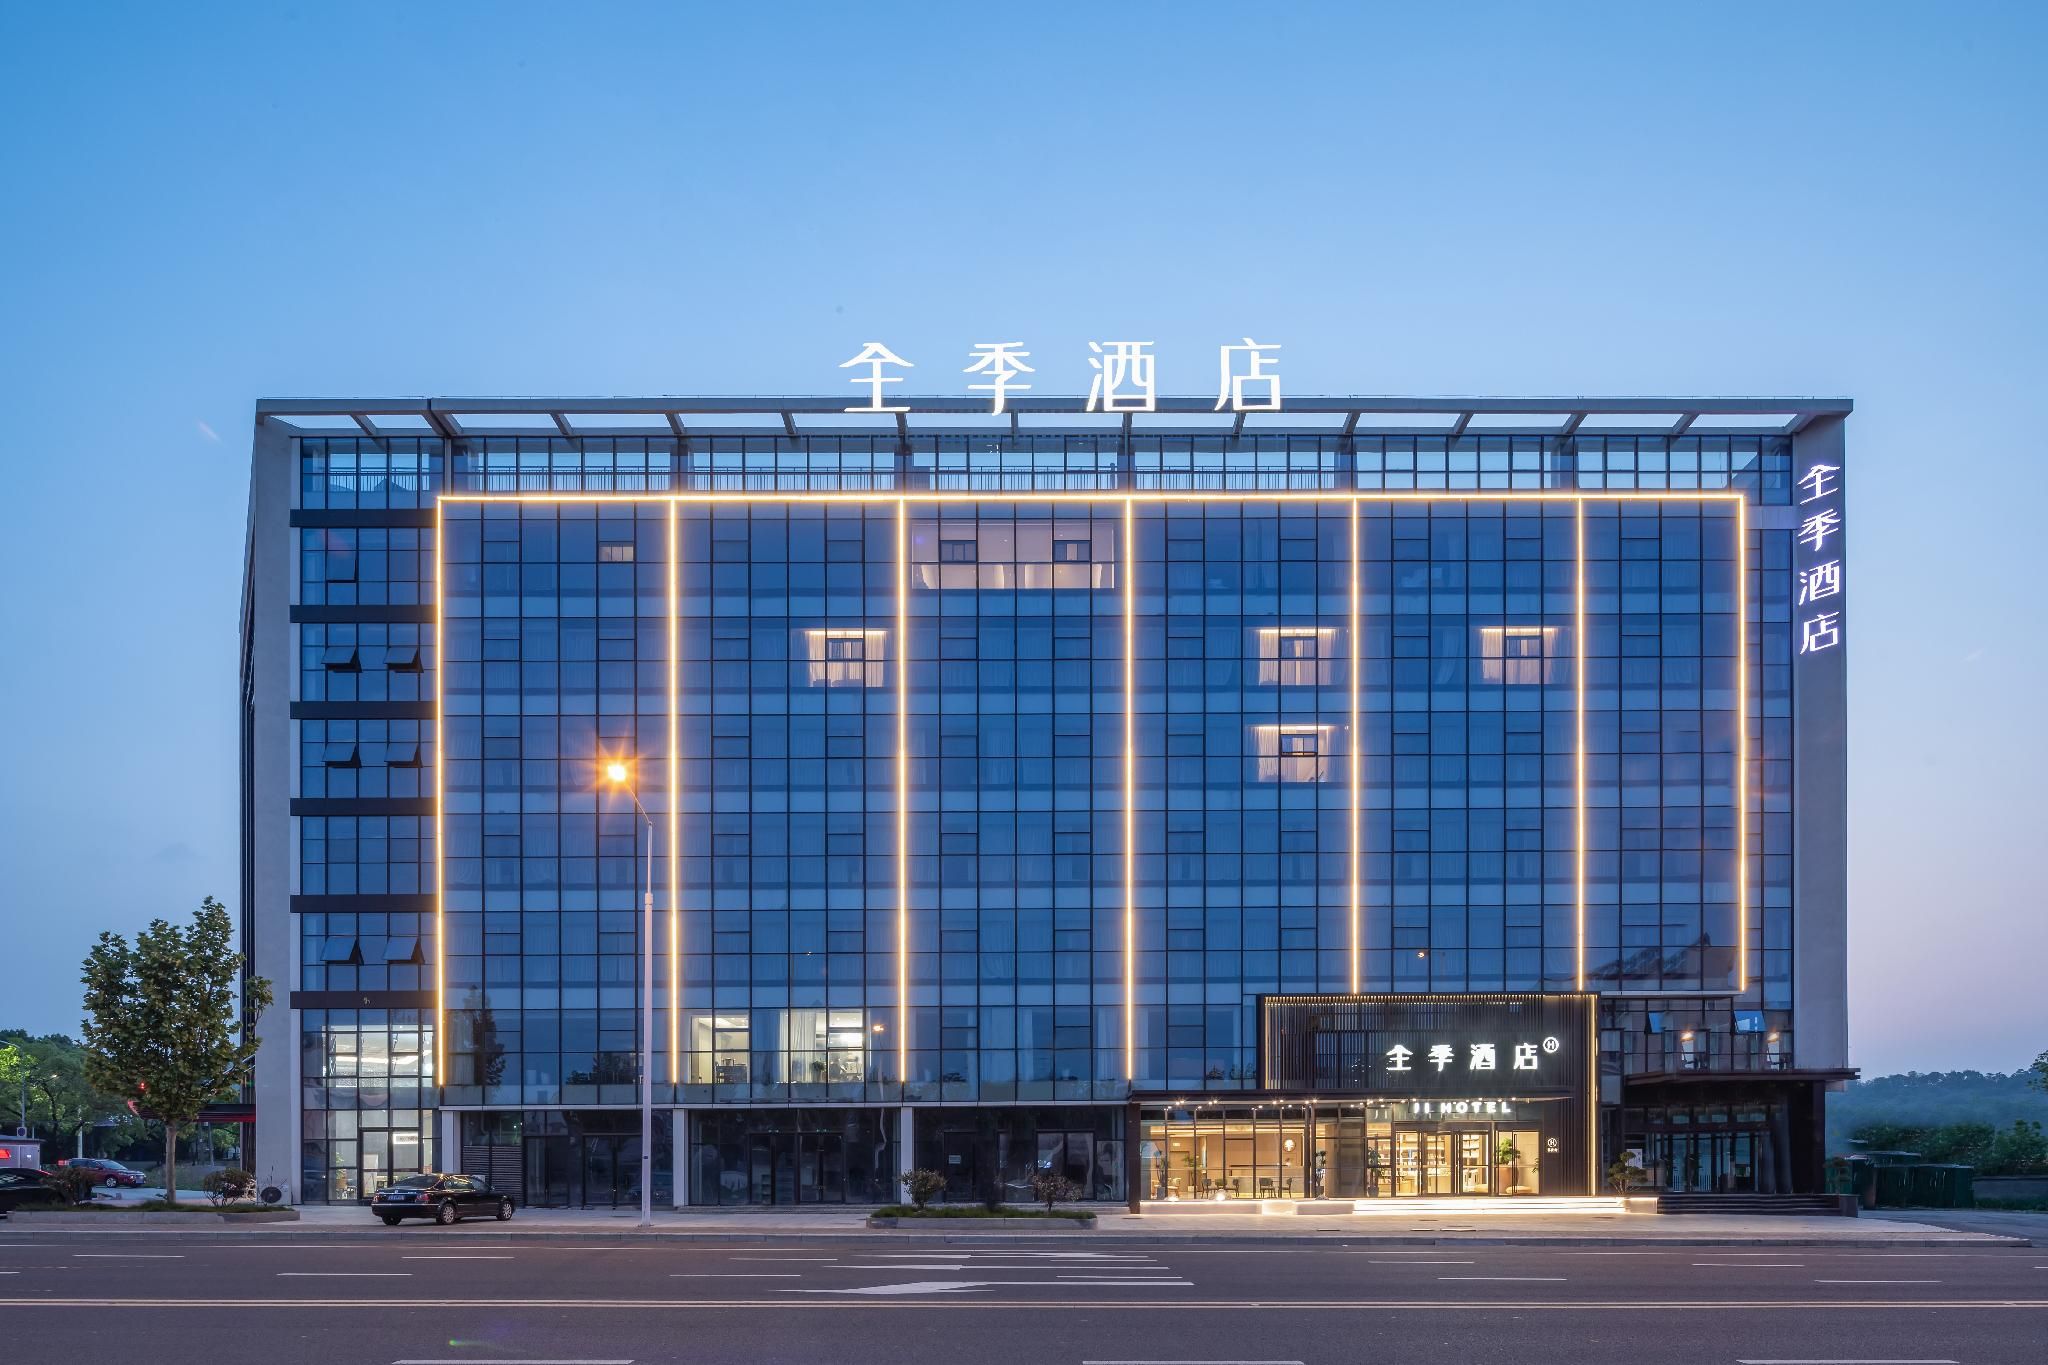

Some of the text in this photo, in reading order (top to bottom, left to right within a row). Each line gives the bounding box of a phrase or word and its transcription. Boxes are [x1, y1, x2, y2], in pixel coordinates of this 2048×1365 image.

[838, 337, 1282, 416] 全季酒店
[1797, 464, 1841, 655] 全季酒店
[1385, 1042, 1538, 1071] 全季酒店
[1440, 1102, 1512, 1114] HOTEL
